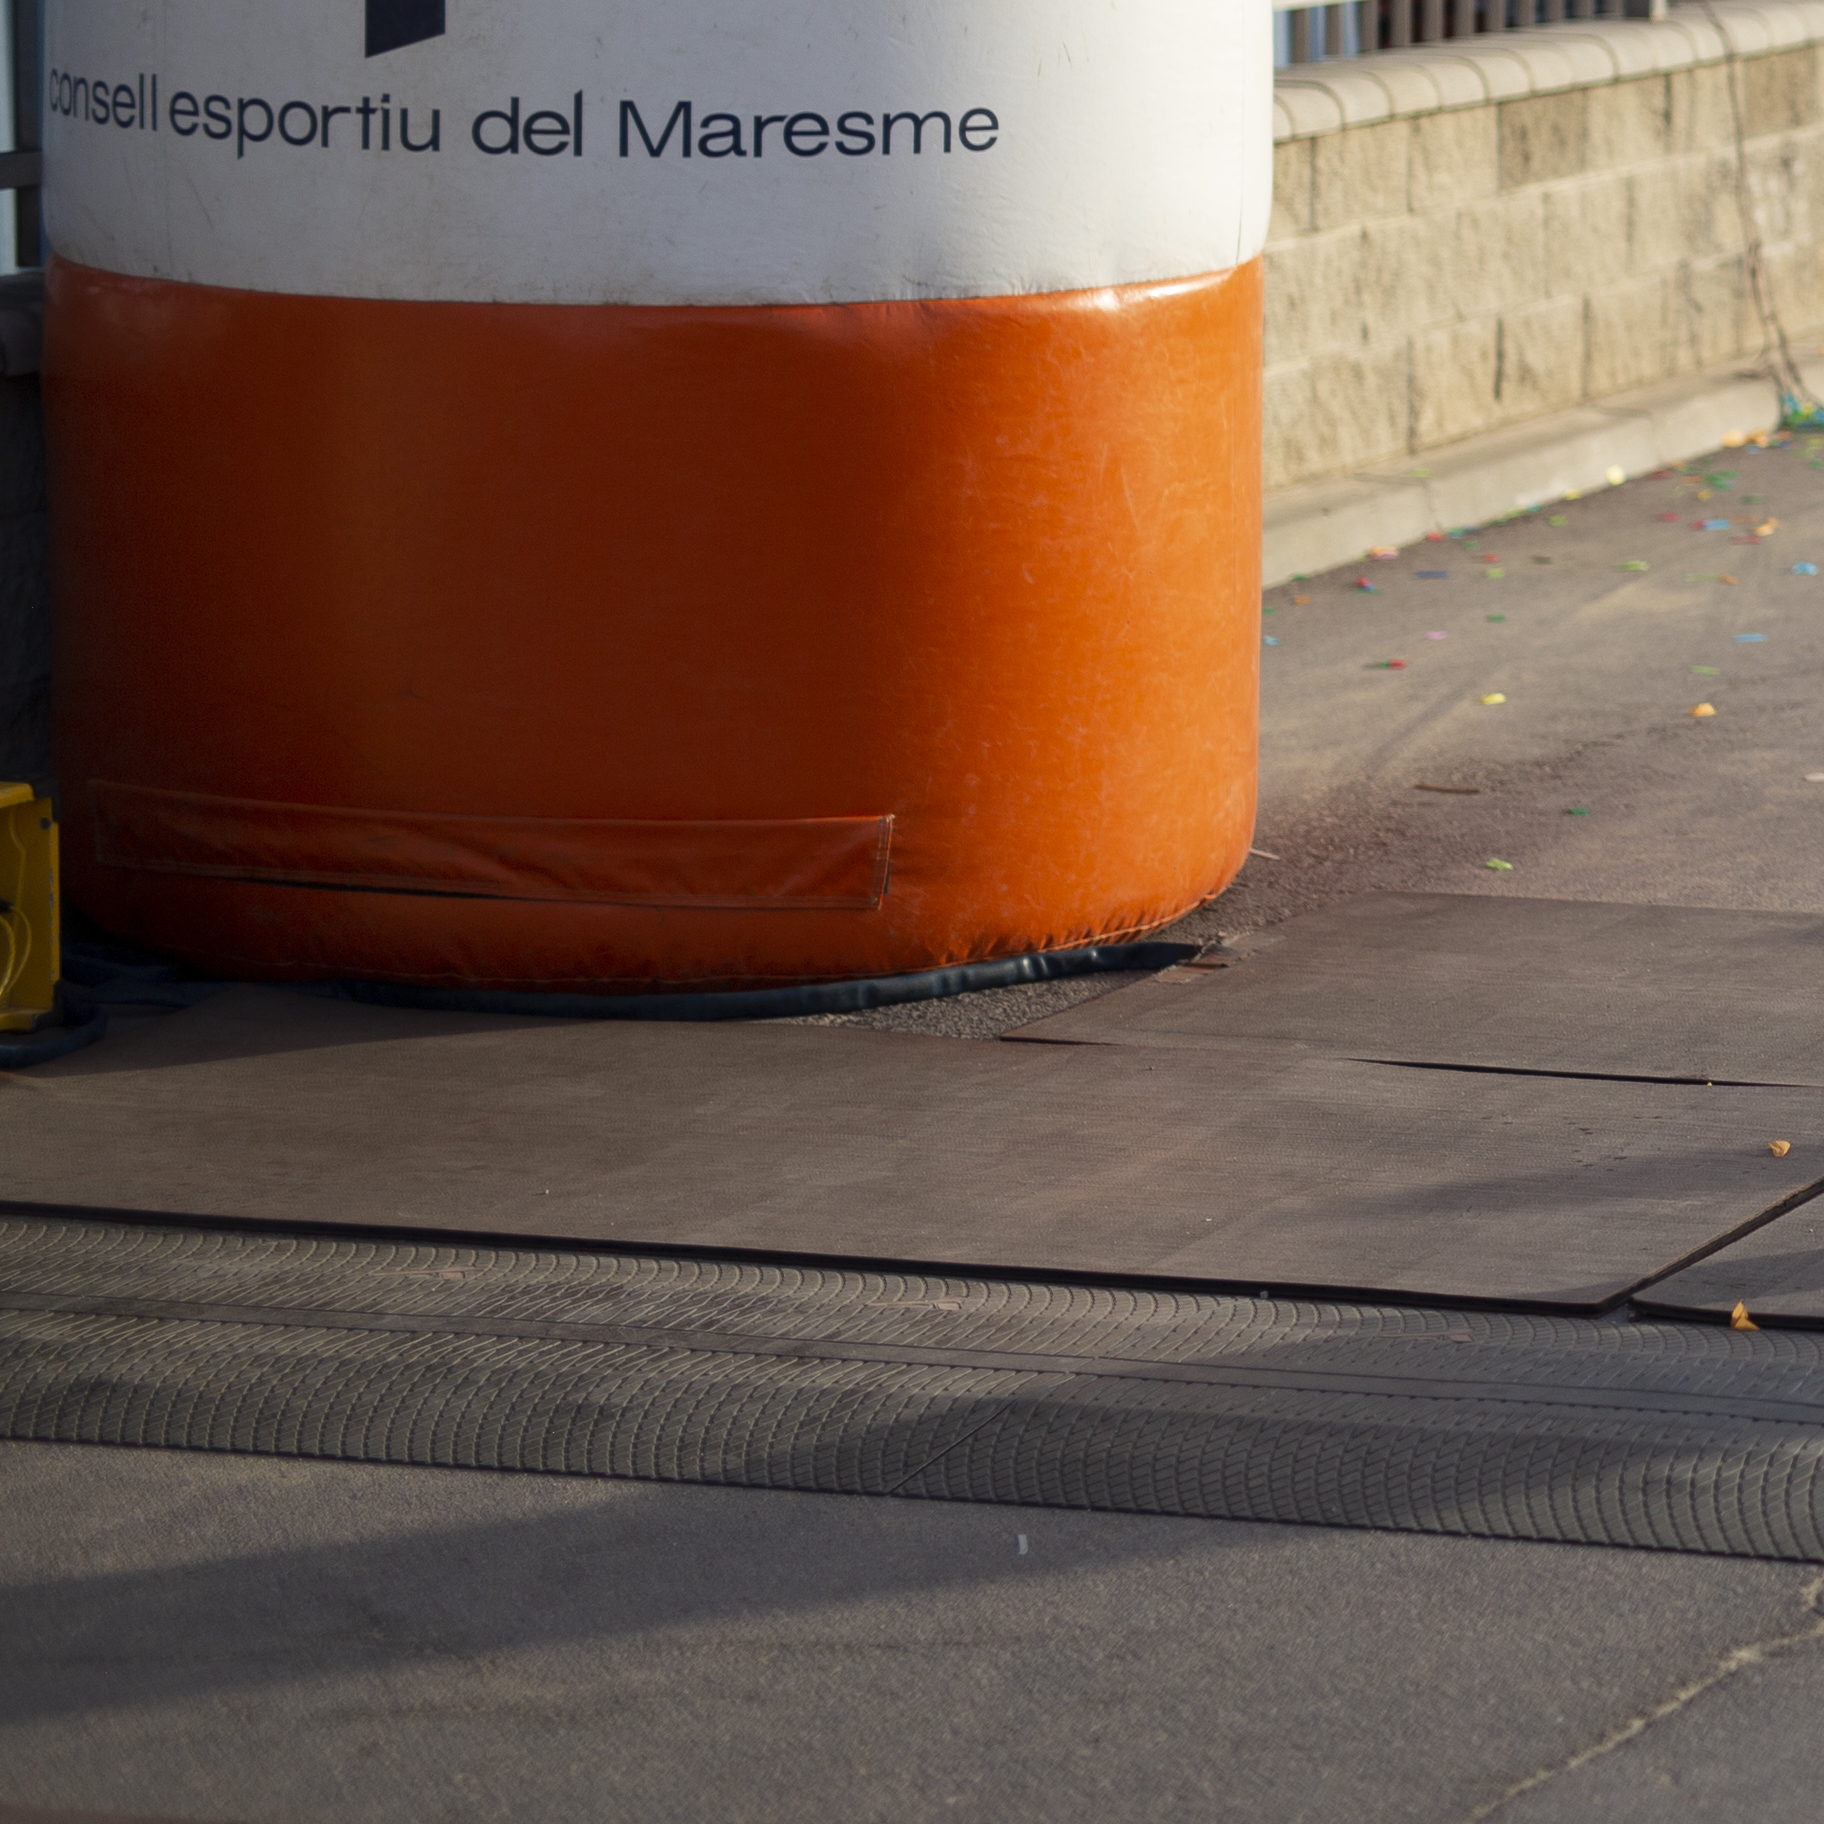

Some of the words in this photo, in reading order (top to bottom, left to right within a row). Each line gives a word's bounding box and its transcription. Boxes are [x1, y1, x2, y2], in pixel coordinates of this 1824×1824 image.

[49, 68, 158, 132] consell
[168, 90, 442, 161] esportiu
[470, 88, 585, 158] del
[617, 98, 1001, 160] Maresme
